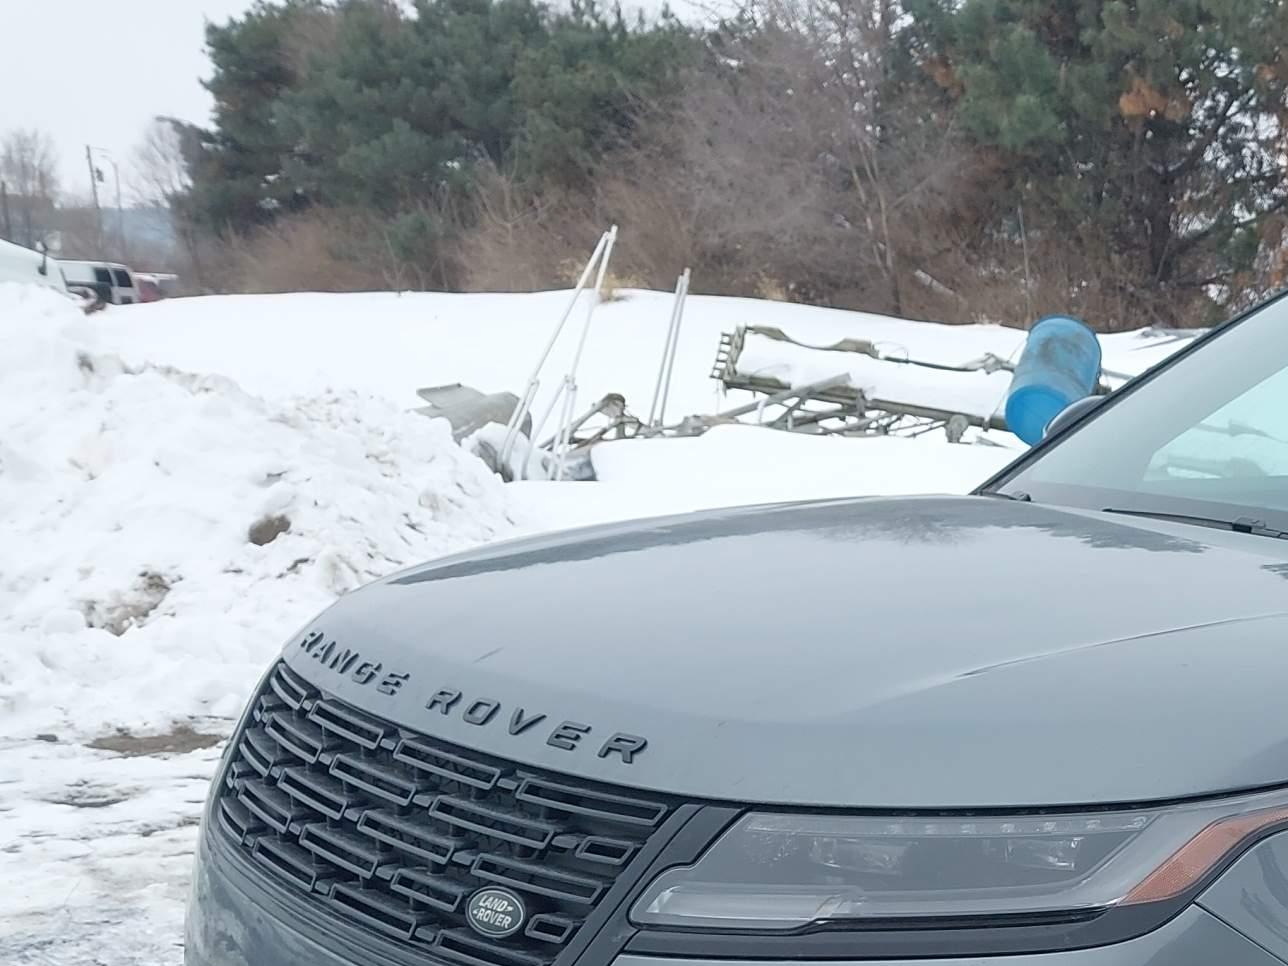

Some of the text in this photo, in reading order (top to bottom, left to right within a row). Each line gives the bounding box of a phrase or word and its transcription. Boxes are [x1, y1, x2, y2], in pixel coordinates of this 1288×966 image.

[300, 631, 648, 764] RANGE ROVER
[478, 894, 509, 912] LAND
[475, 907, 513, 929] ROVER
